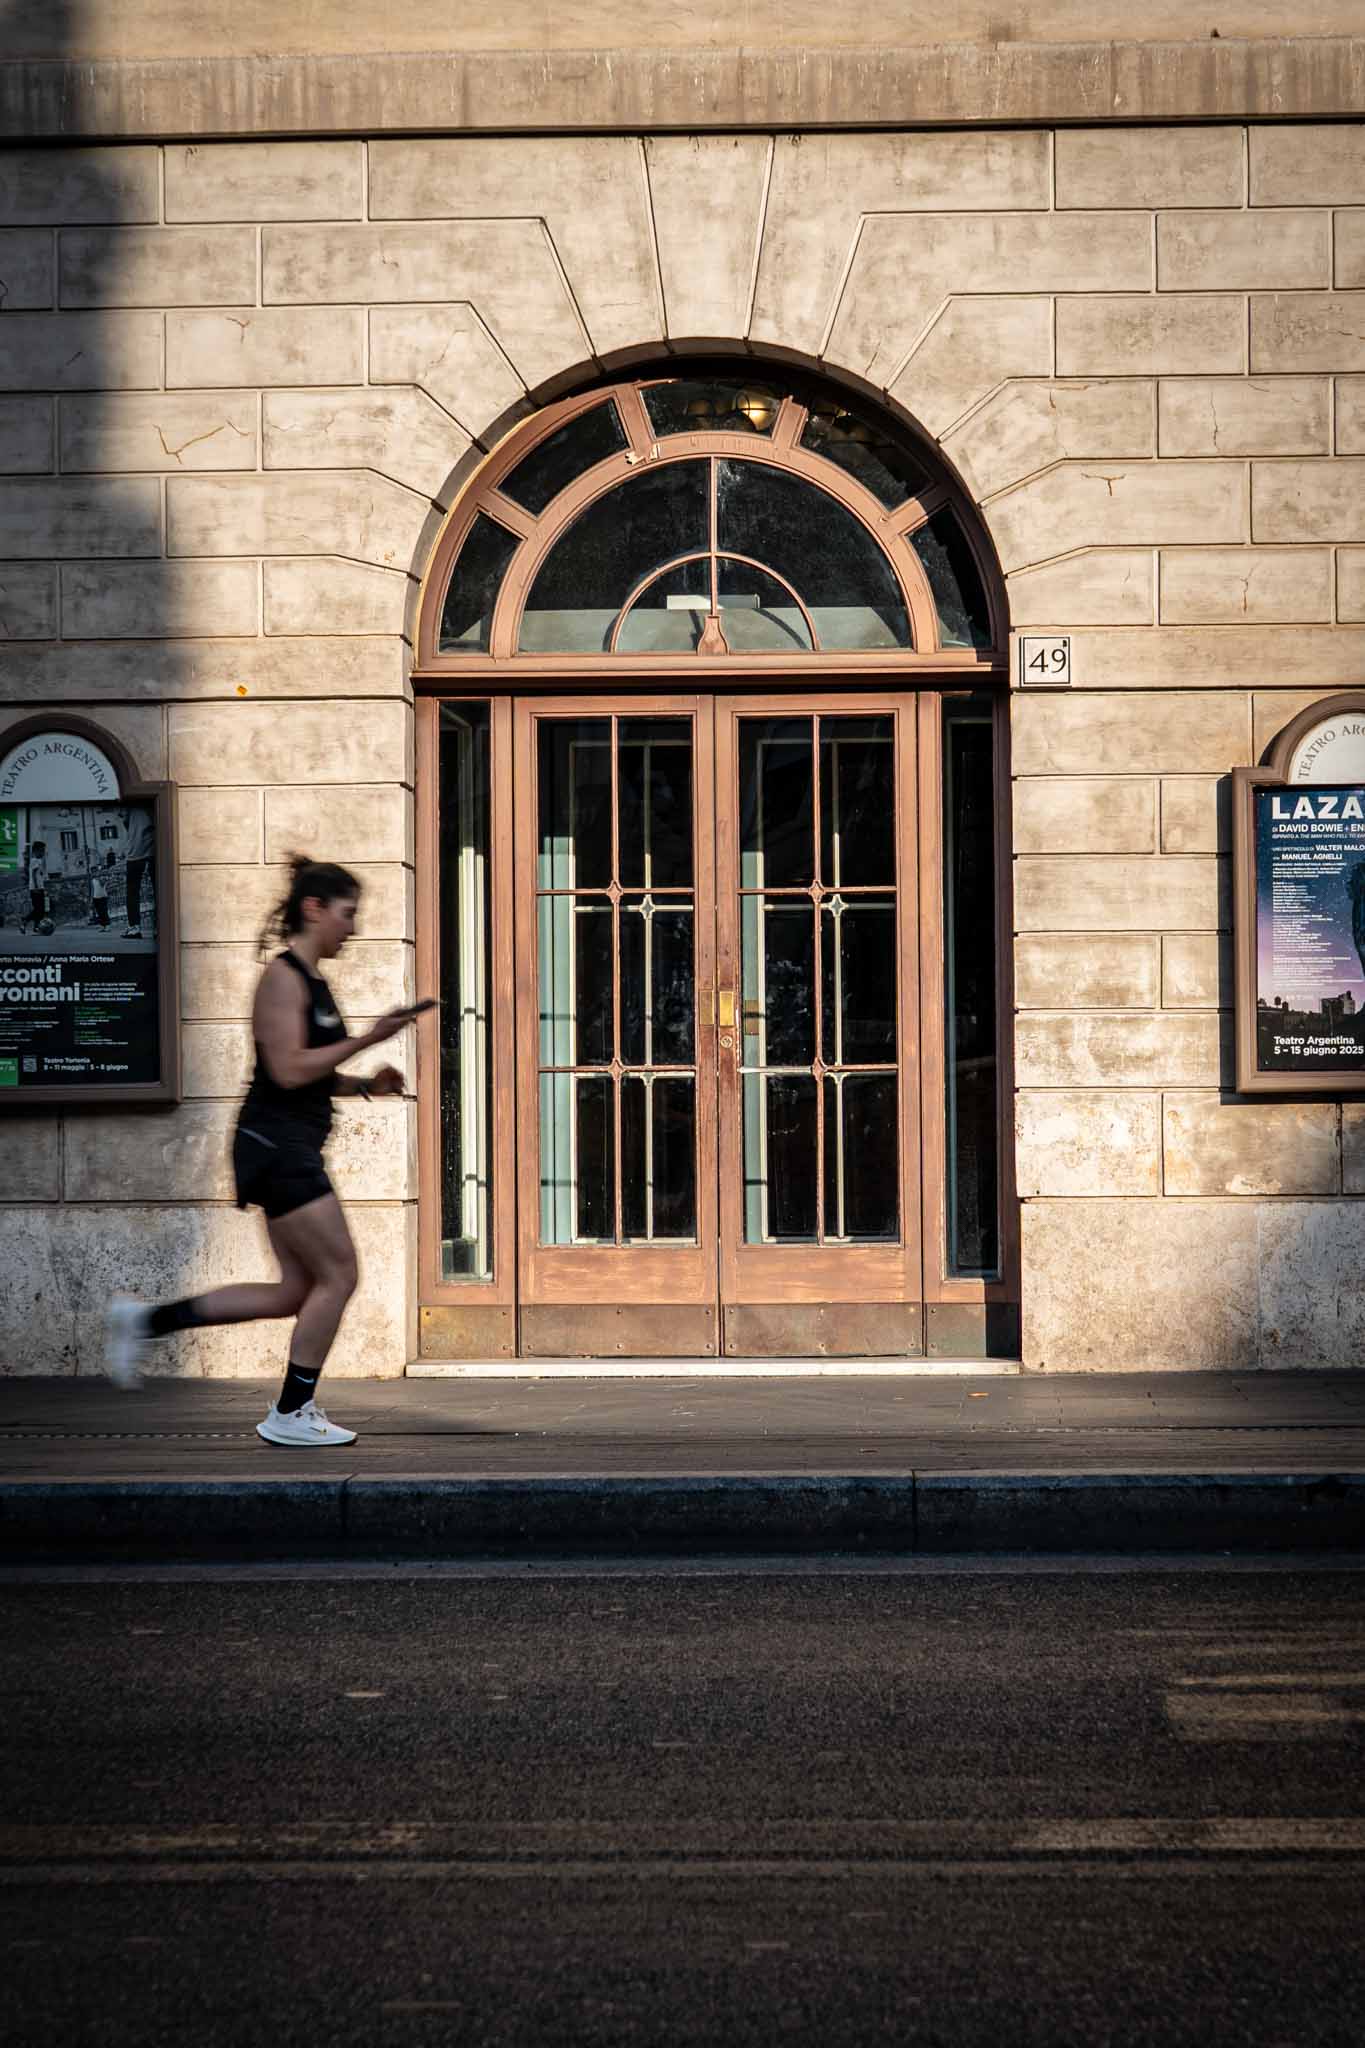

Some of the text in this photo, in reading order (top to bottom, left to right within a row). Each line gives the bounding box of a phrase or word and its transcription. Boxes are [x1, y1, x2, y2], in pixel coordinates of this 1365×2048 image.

[1029, 648, 1066, 673] 49
[1298, 729, 1336, 779] TEATRO
[1, 742, 109, 796] TEATRO ARGENTINA
[1272, 796, 1364, 820] LAZA
[1279, 824, 1308, 832] DAVID
[1311, 824, 1343, 832] BOWIE
[0, 964, 61, 983] conti
[0, 982, 80, 1001] romani
[1273, 1036, 1355, 1046] Teatro Argentina
[1274, 1046, 1280, 1055] 5
[1290, 1046, 1301, 1055] 15
[1303, 1045, 1337, 1056] giugno
[1339, 1046, 1364, 1055] 2025
